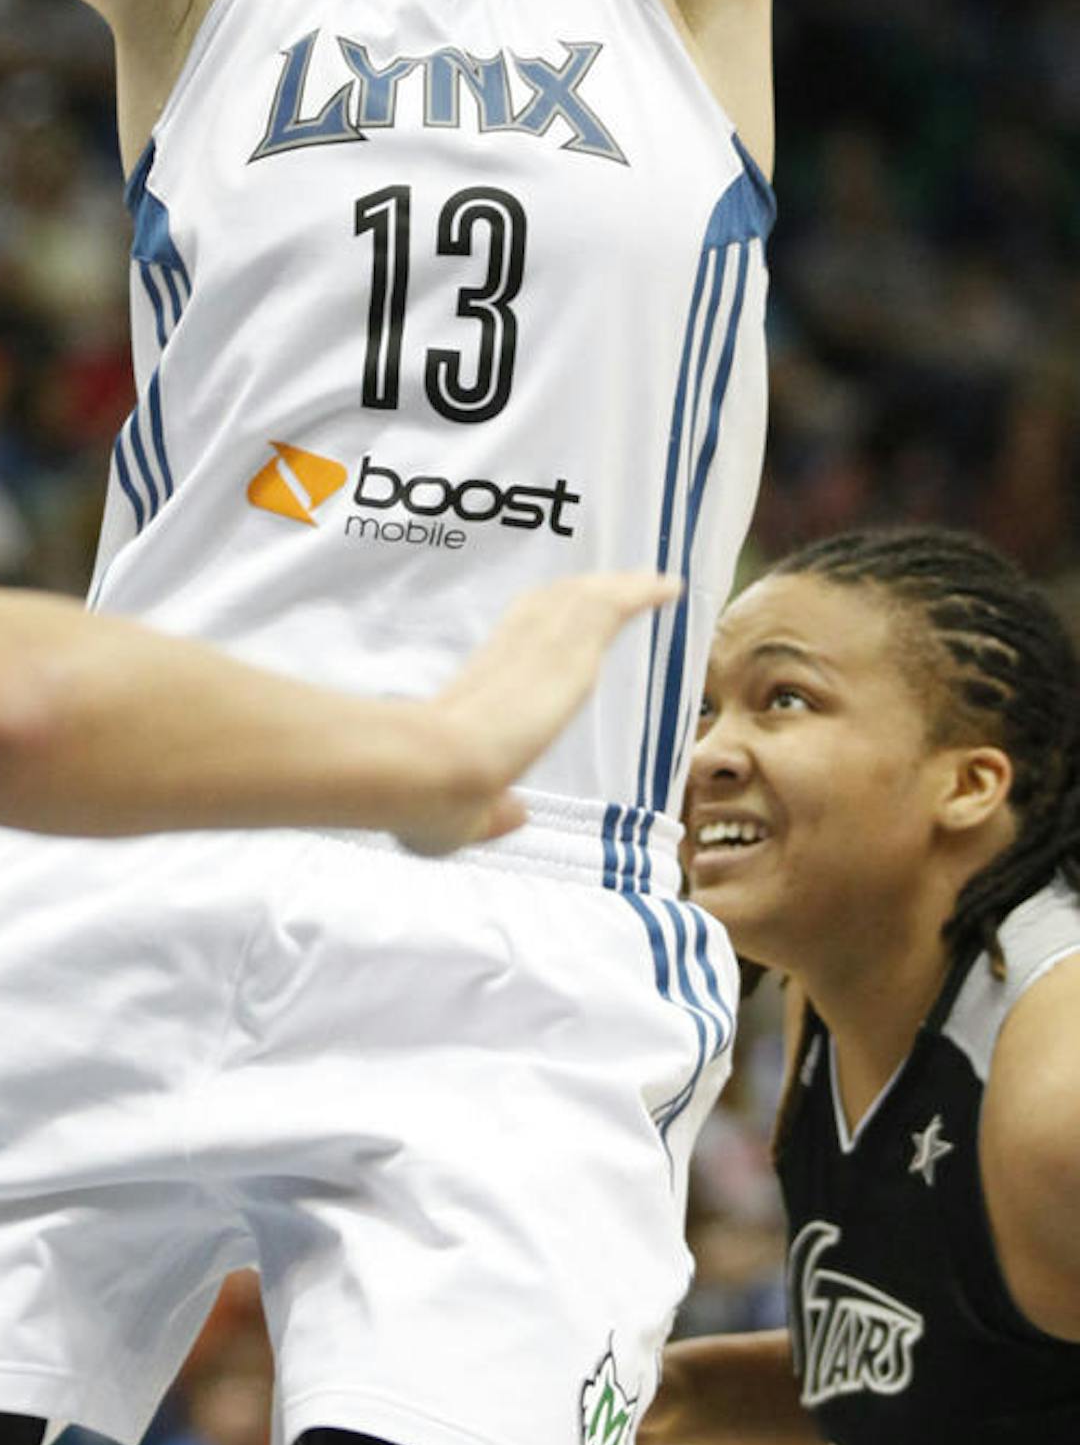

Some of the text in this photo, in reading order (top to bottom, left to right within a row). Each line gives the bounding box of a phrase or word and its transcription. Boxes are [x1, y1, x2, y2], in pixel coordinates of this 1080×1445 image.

[247, 28, 630, 167] LYNX
[354, 184, 528, 424] 13
[344, 515, 467, 550] mobile
[353, 455, 581, 538] boost
